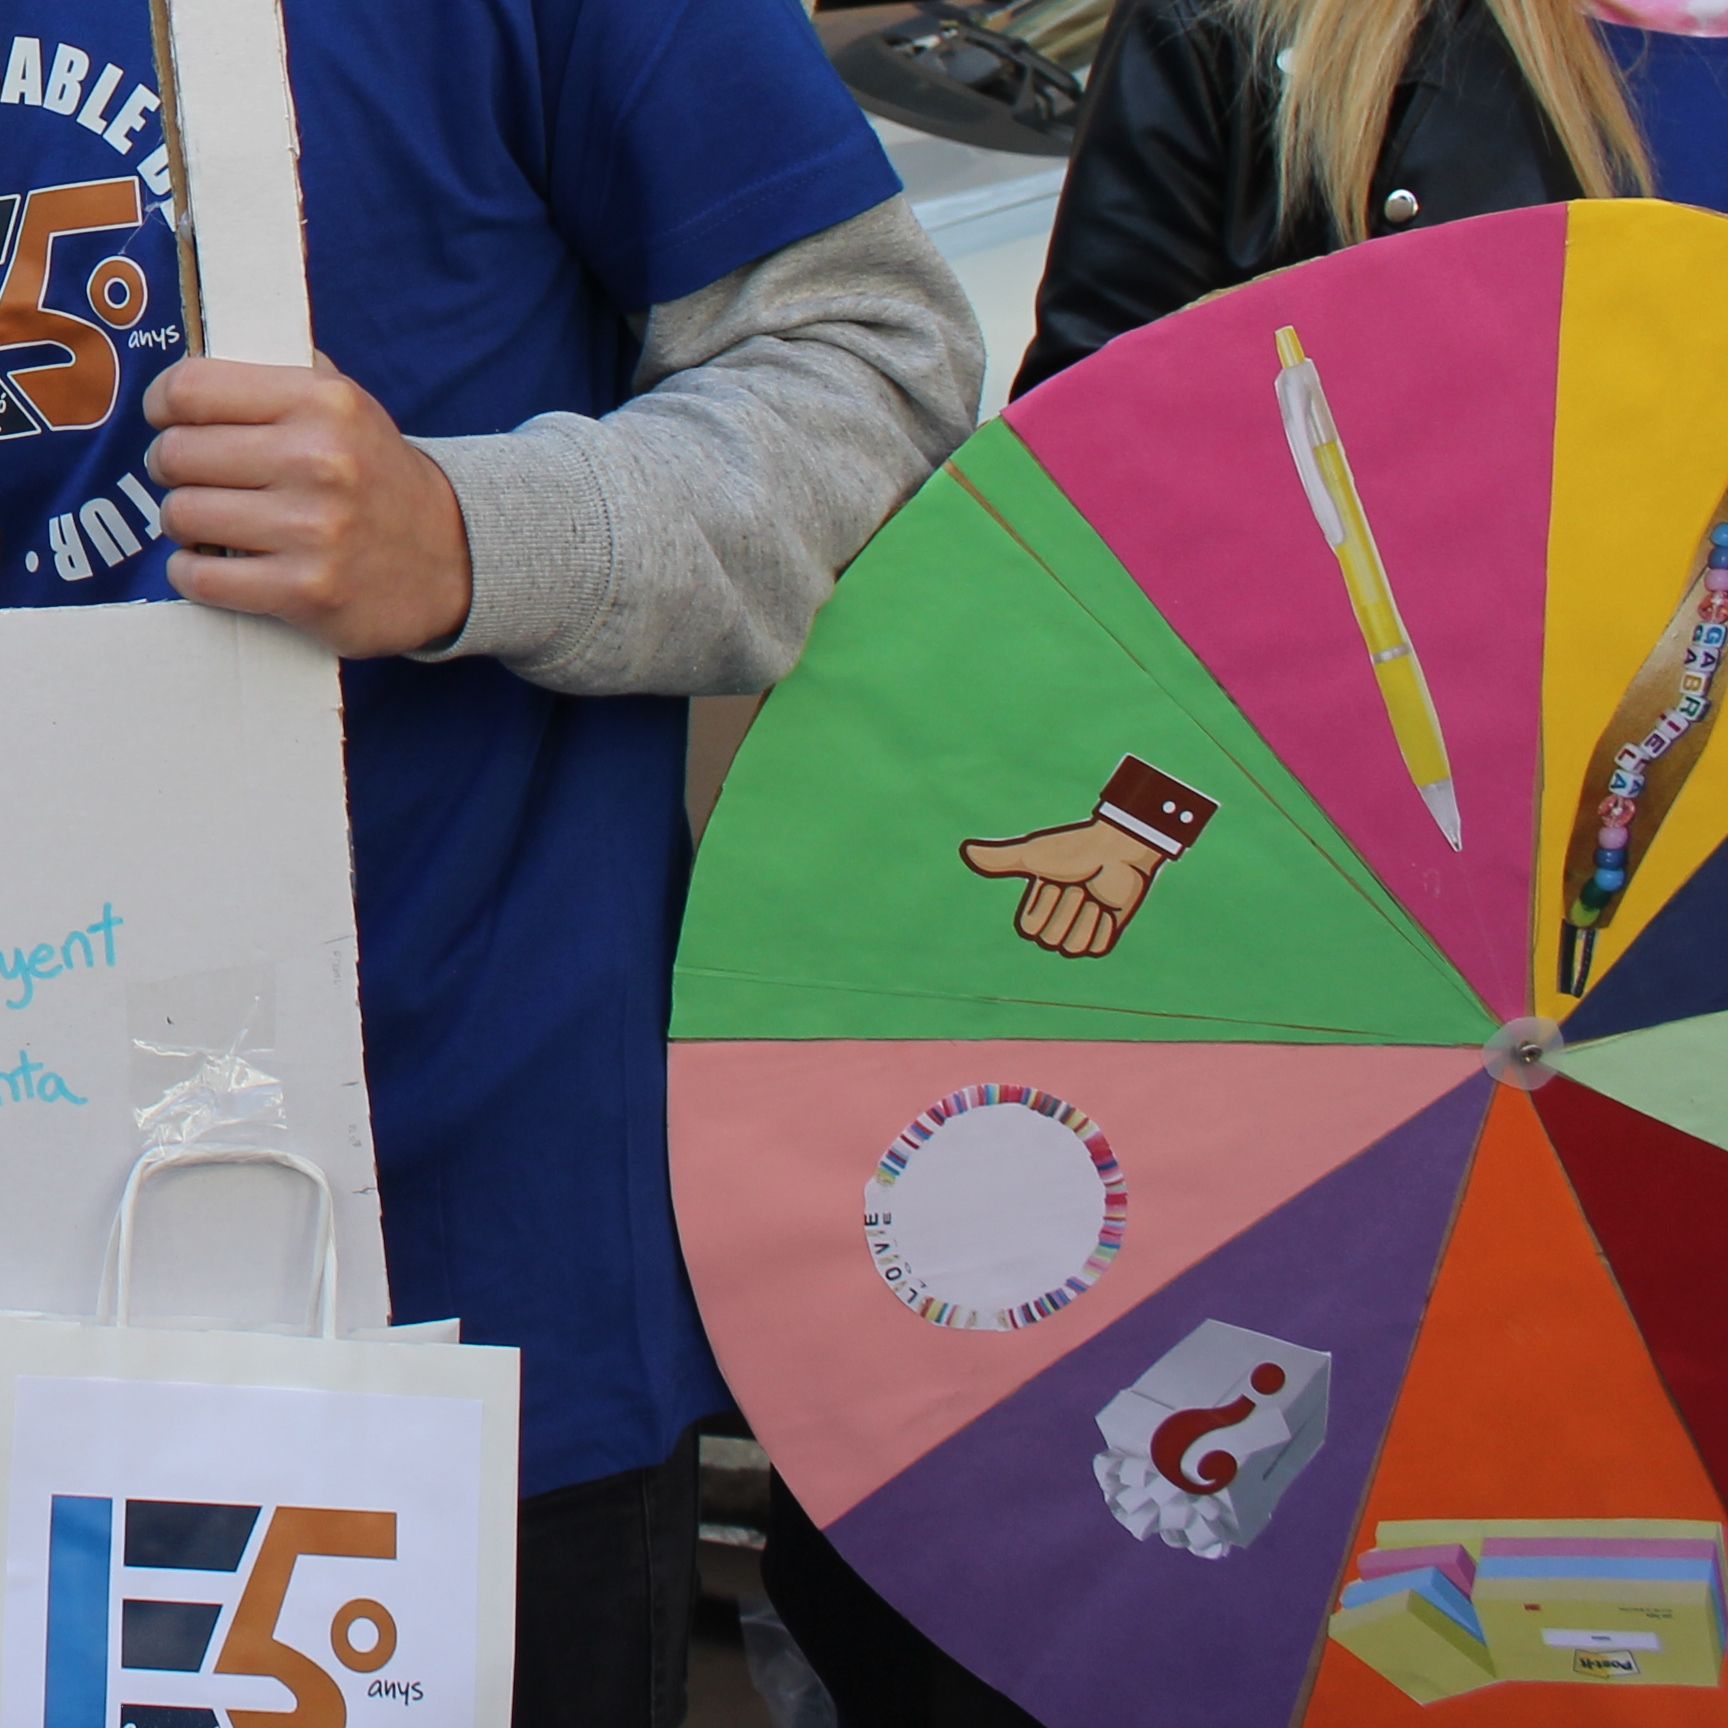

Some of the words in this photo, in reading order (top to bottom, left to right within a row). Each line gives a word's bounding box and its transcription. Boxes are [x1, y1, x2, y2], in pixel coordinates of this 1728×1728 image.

[127, 321, 181, 350] anys
[1606, 624, 1726, 798] GABRIELA
[367, 1676, 425, 1702] anys
